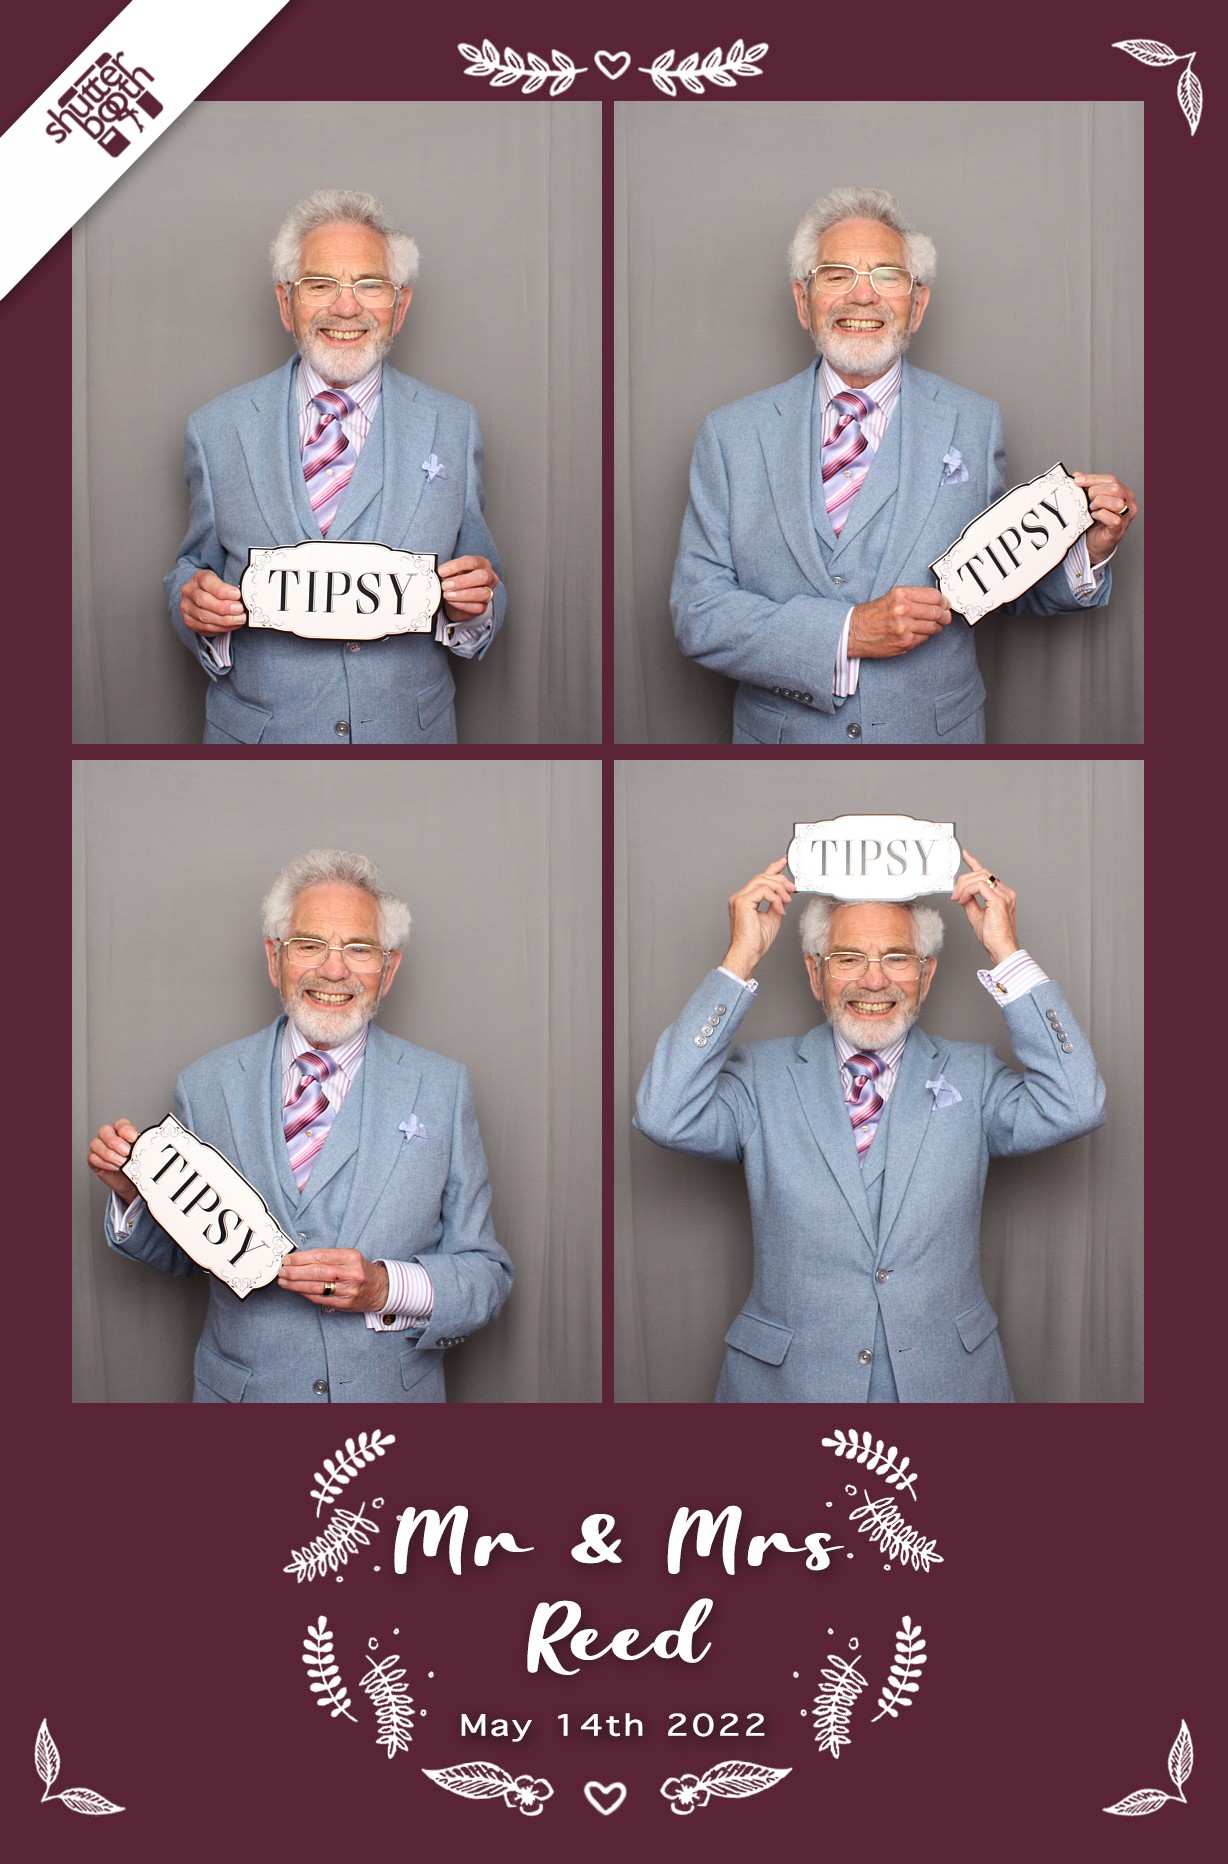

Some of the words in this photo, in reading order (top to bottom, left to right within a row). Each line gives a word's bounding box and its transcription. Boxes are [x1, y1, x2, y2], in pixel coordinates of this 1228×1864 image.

[957, 487, 1069, 596] TIPSY
[268, 569, 419, 615] TIPSY
[810, 839, 940, 877] TIPSY
[150, 1143, 270, 1268] TIPSY
